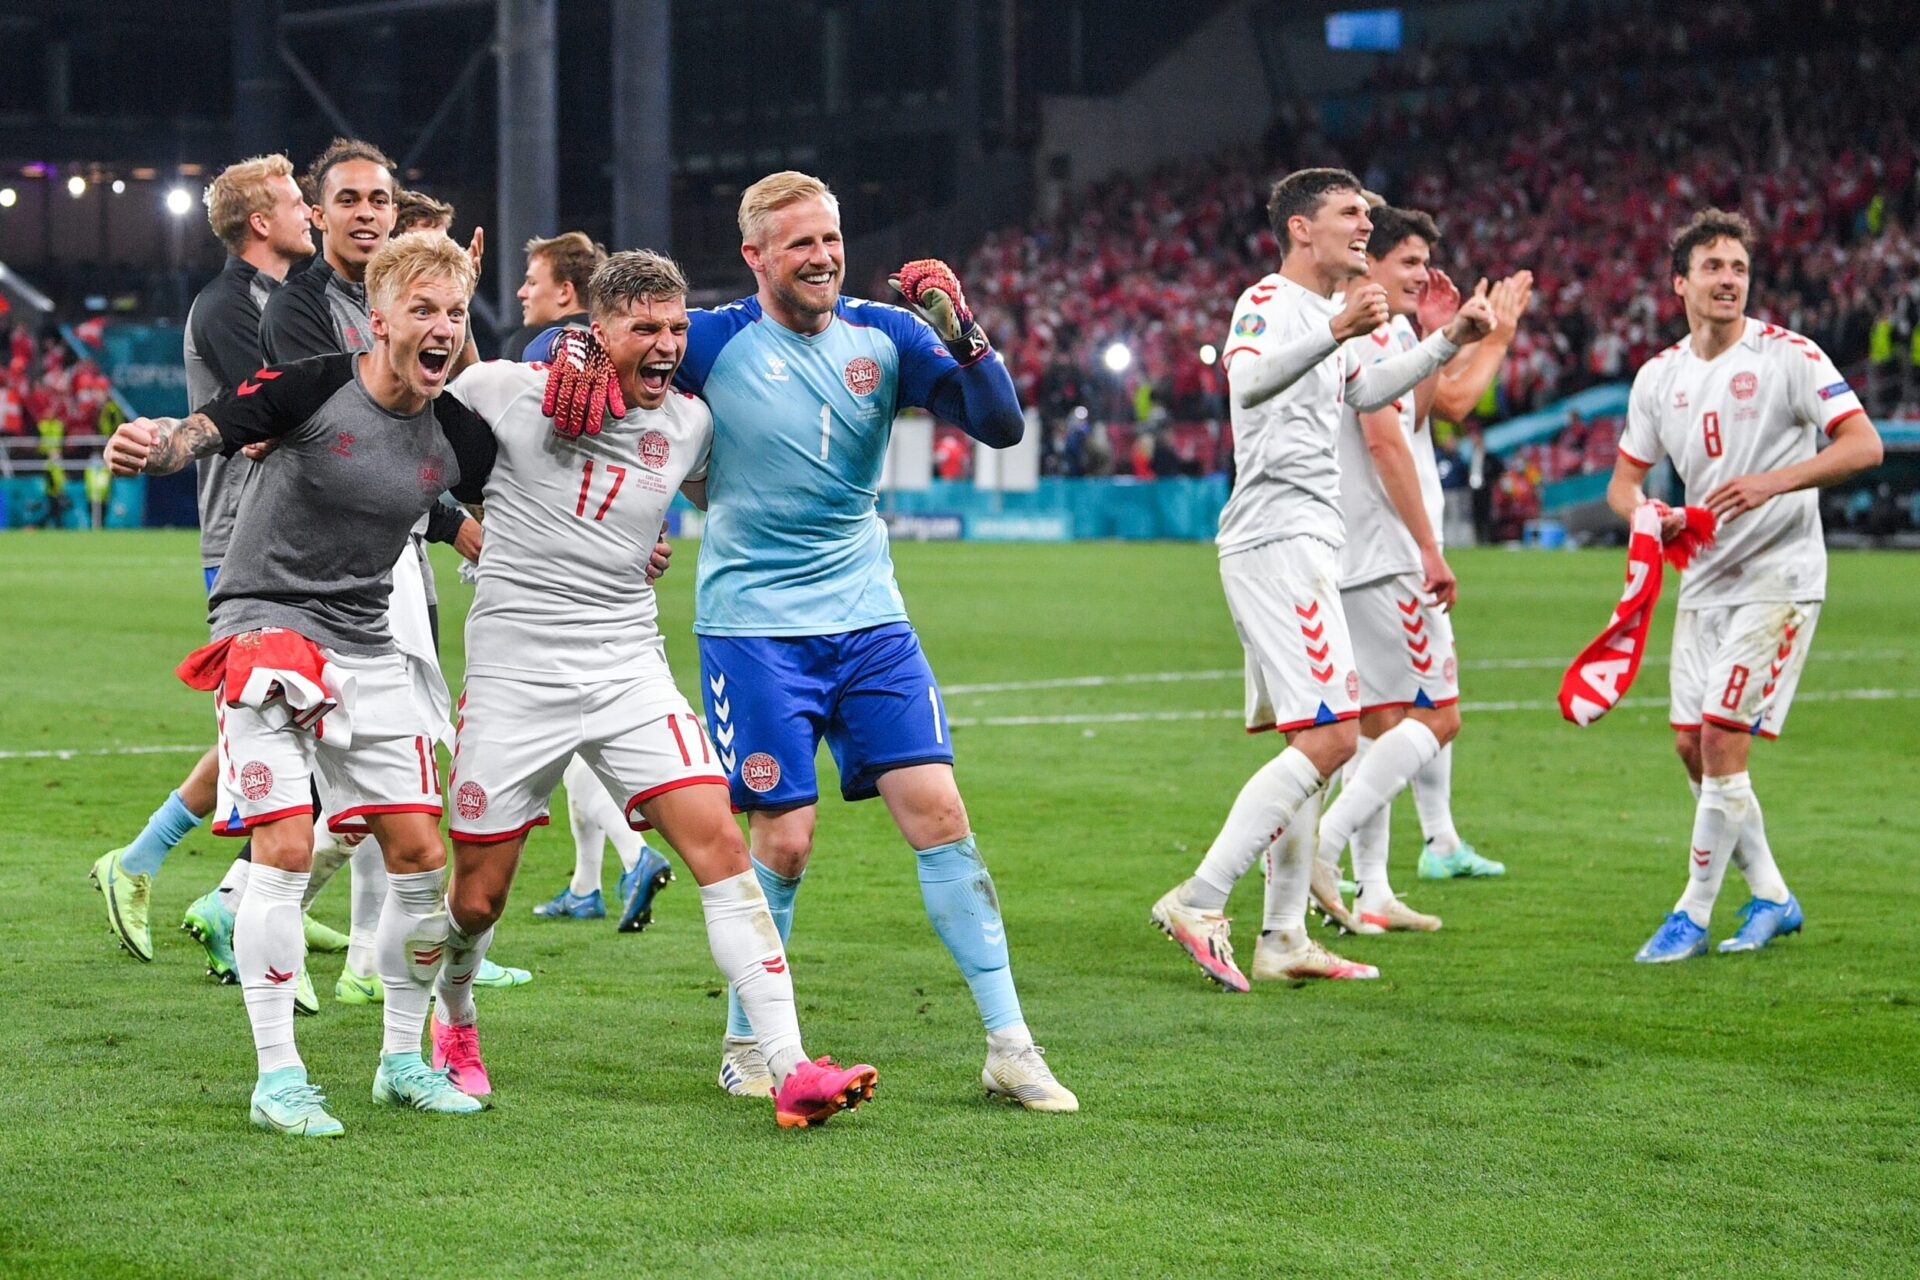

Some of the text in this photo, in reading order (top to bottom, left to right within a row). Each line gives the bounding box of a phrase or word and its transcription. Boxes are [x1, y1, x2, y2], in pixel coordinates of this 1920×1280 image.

[851, 368, 873, 383] DBU
[820, 403, 831, 460] 1
[1703, 411, 1723, 458] 8
[643, 443, 663, 457] DBU
[575, 460, 627, 521] 17
[1721, 664, 1749, 711] 8
[928, 686, 943, 744] 1
[245, 773, 266, 789] DBU
[750, 766, 772, 778] DBU
[462, 794, 480, 807] DBU
